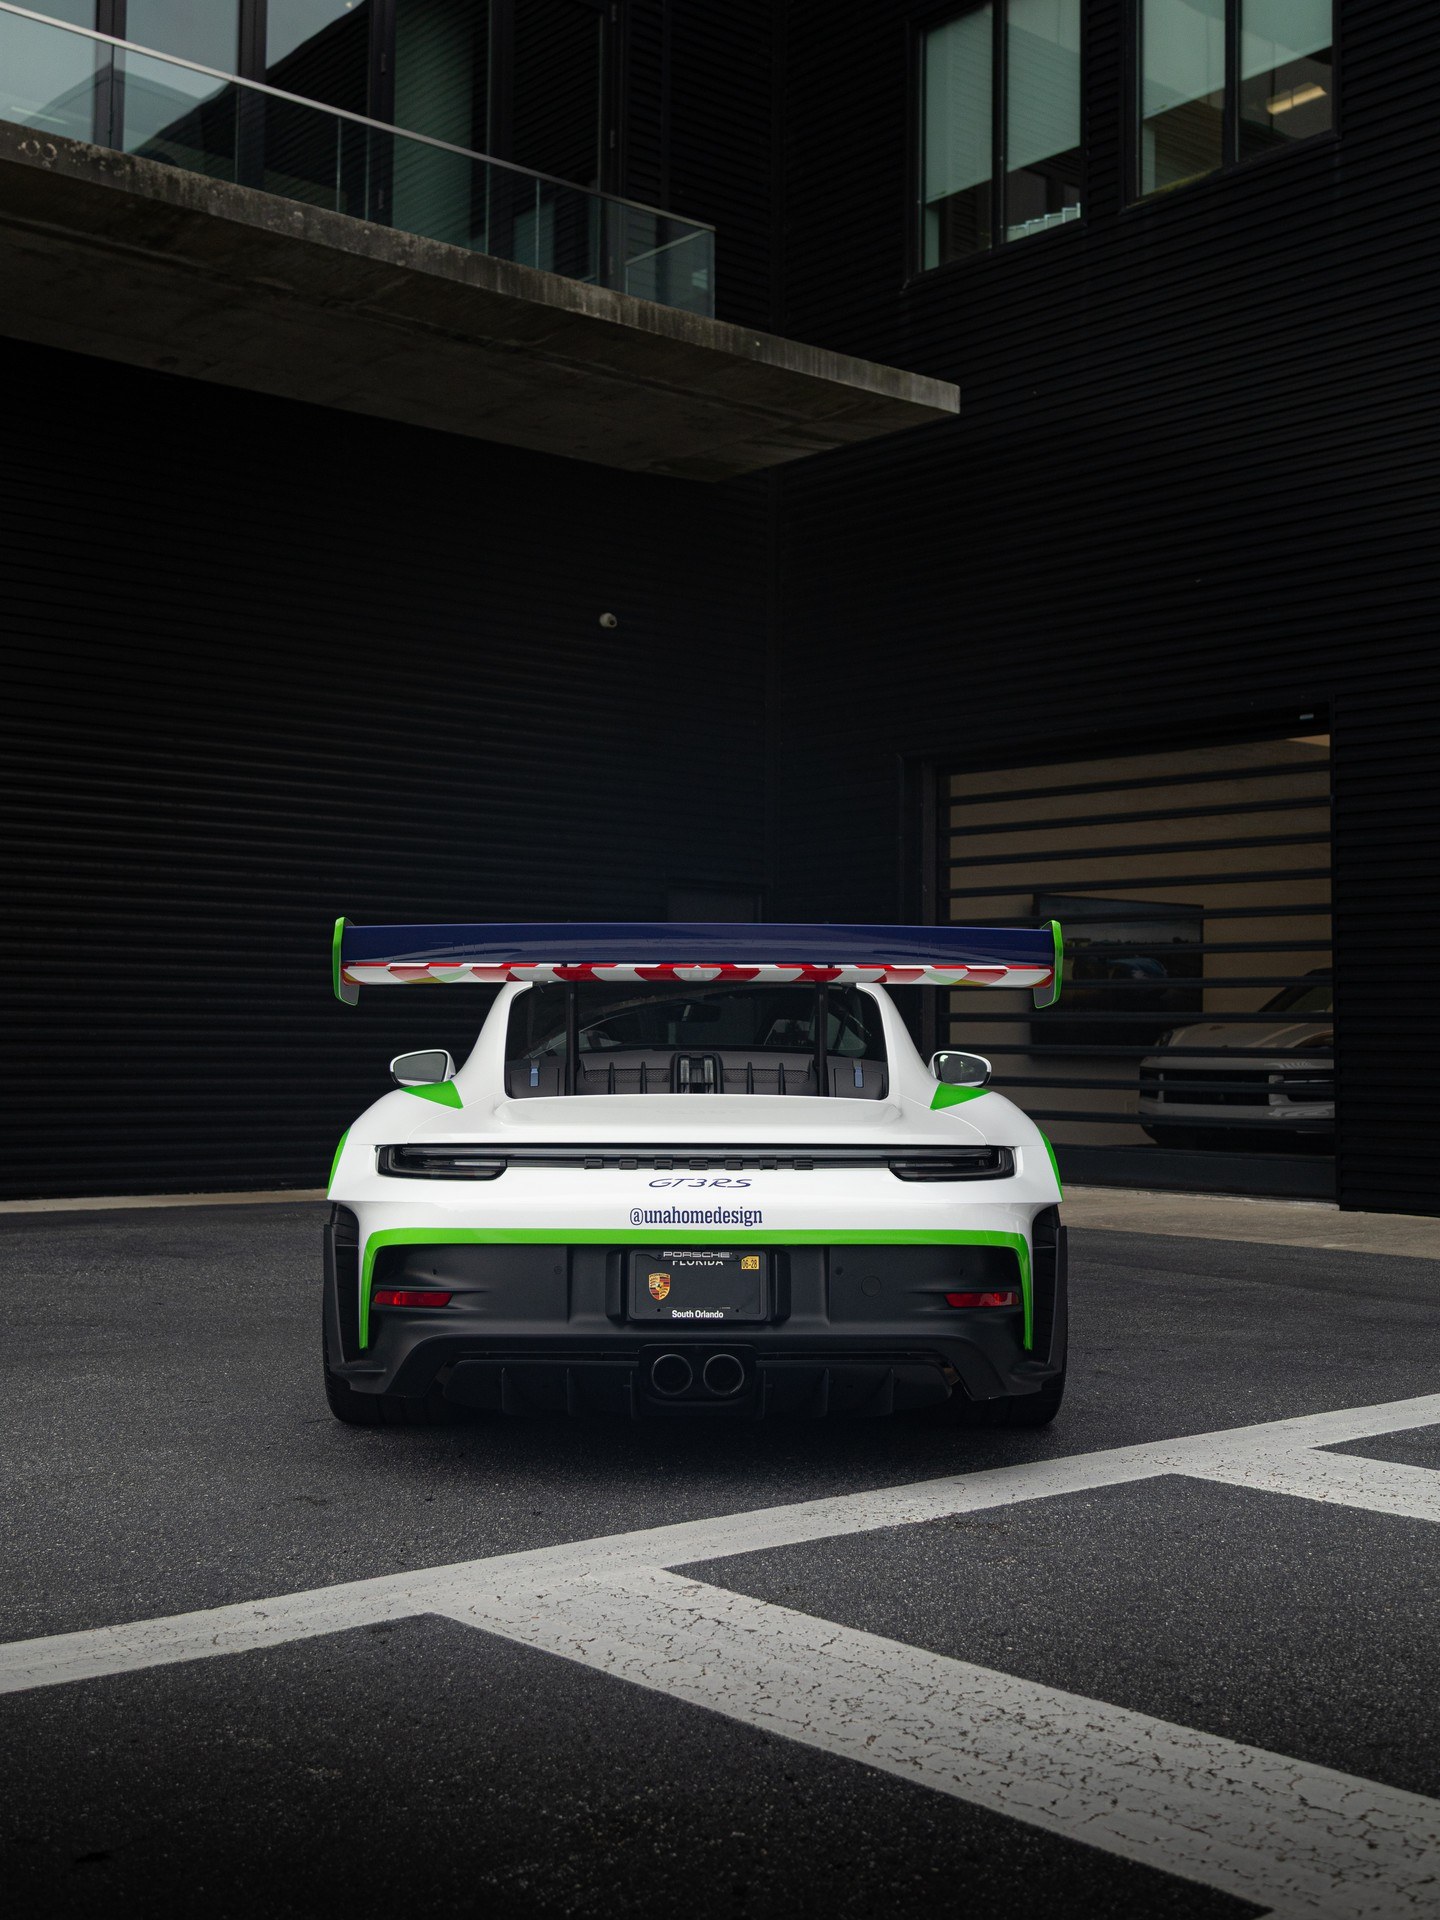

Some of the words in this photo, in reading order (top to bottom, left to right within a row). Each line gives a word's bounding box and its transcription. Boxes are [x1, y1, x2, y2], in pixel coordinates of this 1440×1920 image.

[629, 1206, 763, 1226] @unahomedesign
[671, 1309, 694, 1319] South
[694, 1309, 724, 1319] Orlando
